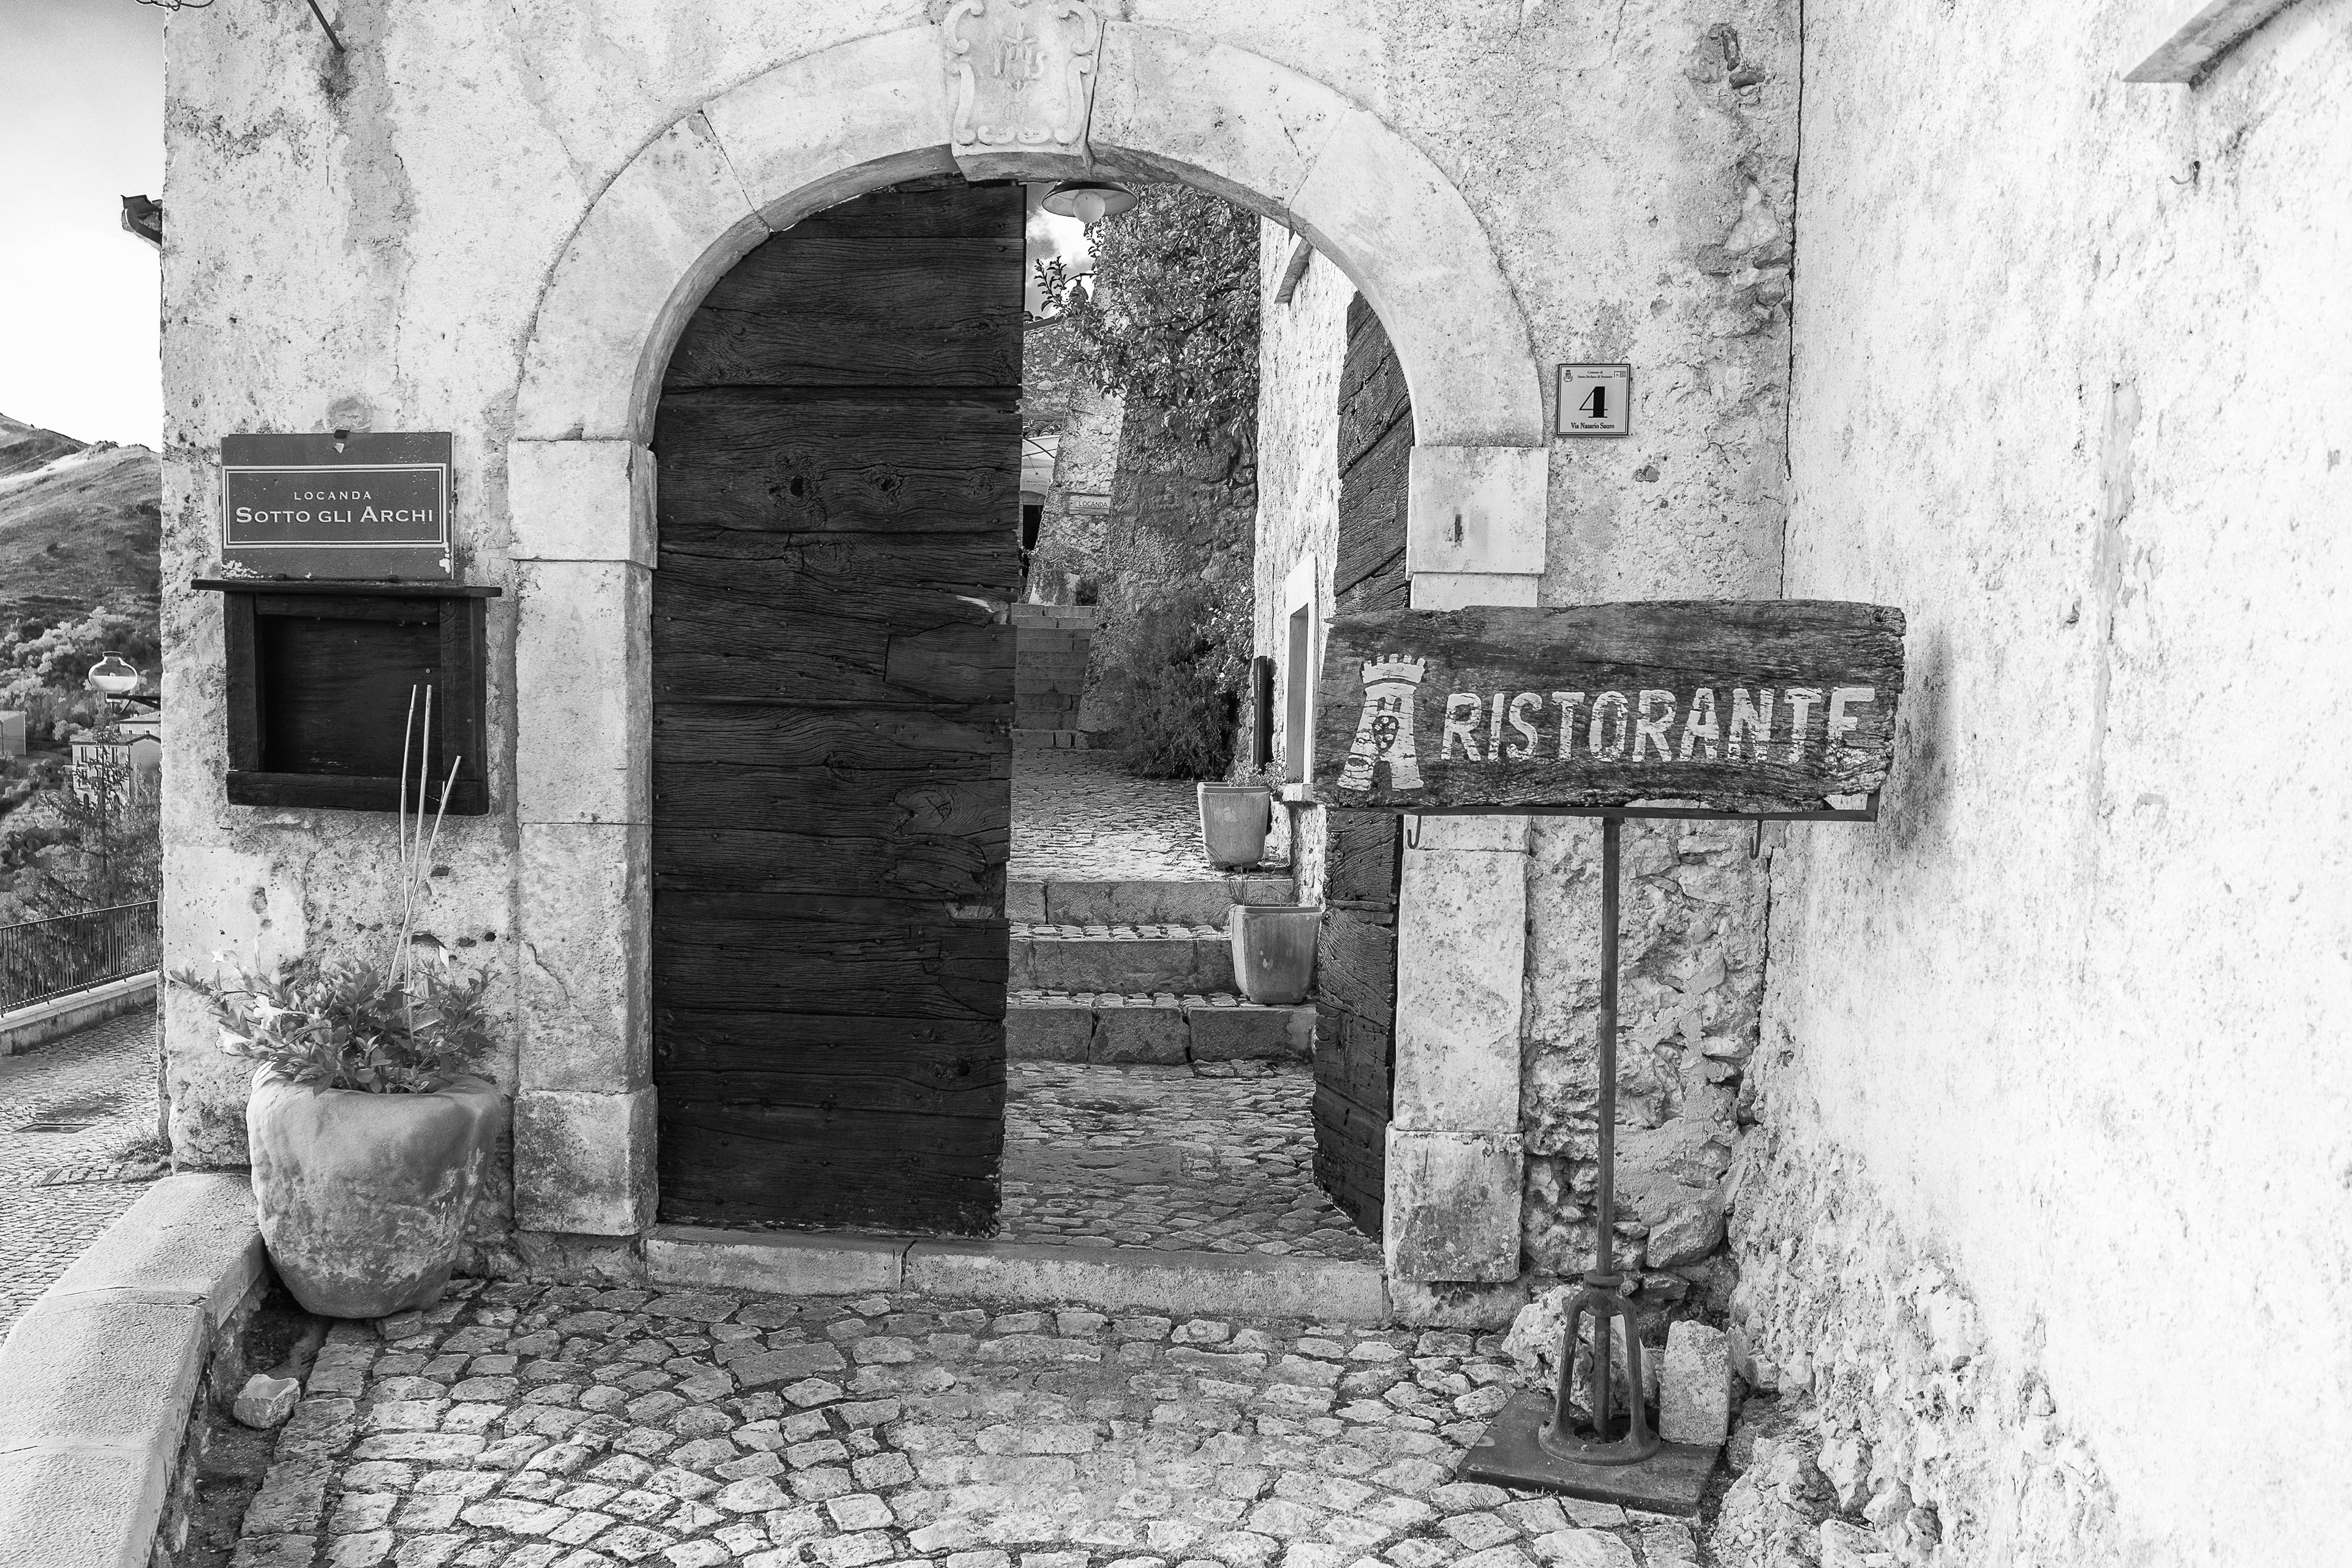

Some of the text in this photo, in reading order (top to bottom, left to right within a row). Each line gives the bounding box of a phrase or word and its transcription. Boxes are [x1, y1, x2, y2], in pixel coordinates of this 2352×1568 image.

[1578, 386, 1608, 418] 4
[293, 491, 372, 500] LOCANDA
[235, 505, 432, 524] SOTTO GLI ARCHI
[1441, 686, 1876, 764] RISTORANTE
